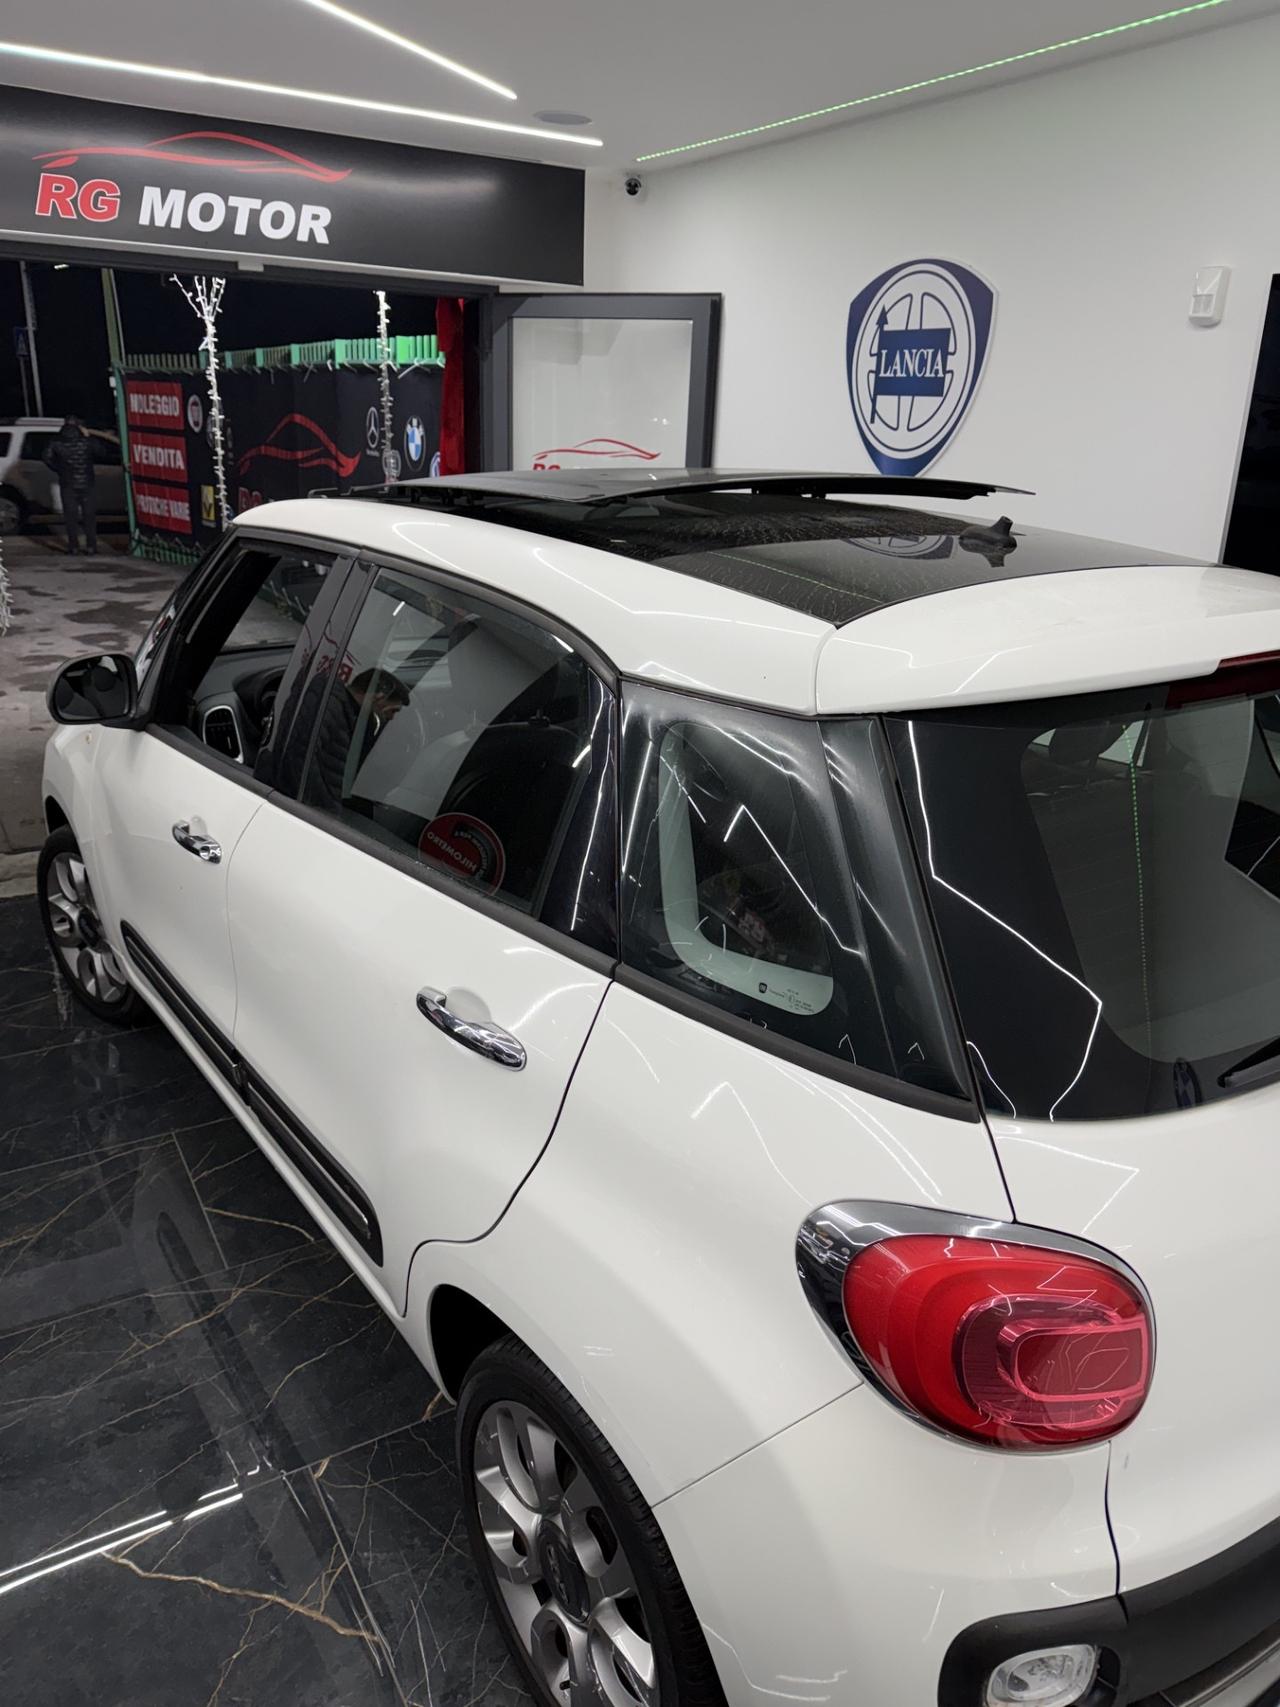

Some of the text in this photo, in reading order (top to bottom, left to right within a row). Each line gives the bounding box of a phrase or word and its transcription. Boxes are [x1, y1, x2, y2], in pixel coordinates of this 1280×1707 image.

[35, 173, 331, 243] RG MOTOR
[879, 349, 944, 377] LANCIA
[134, 445, 184, 469] VENDITA
